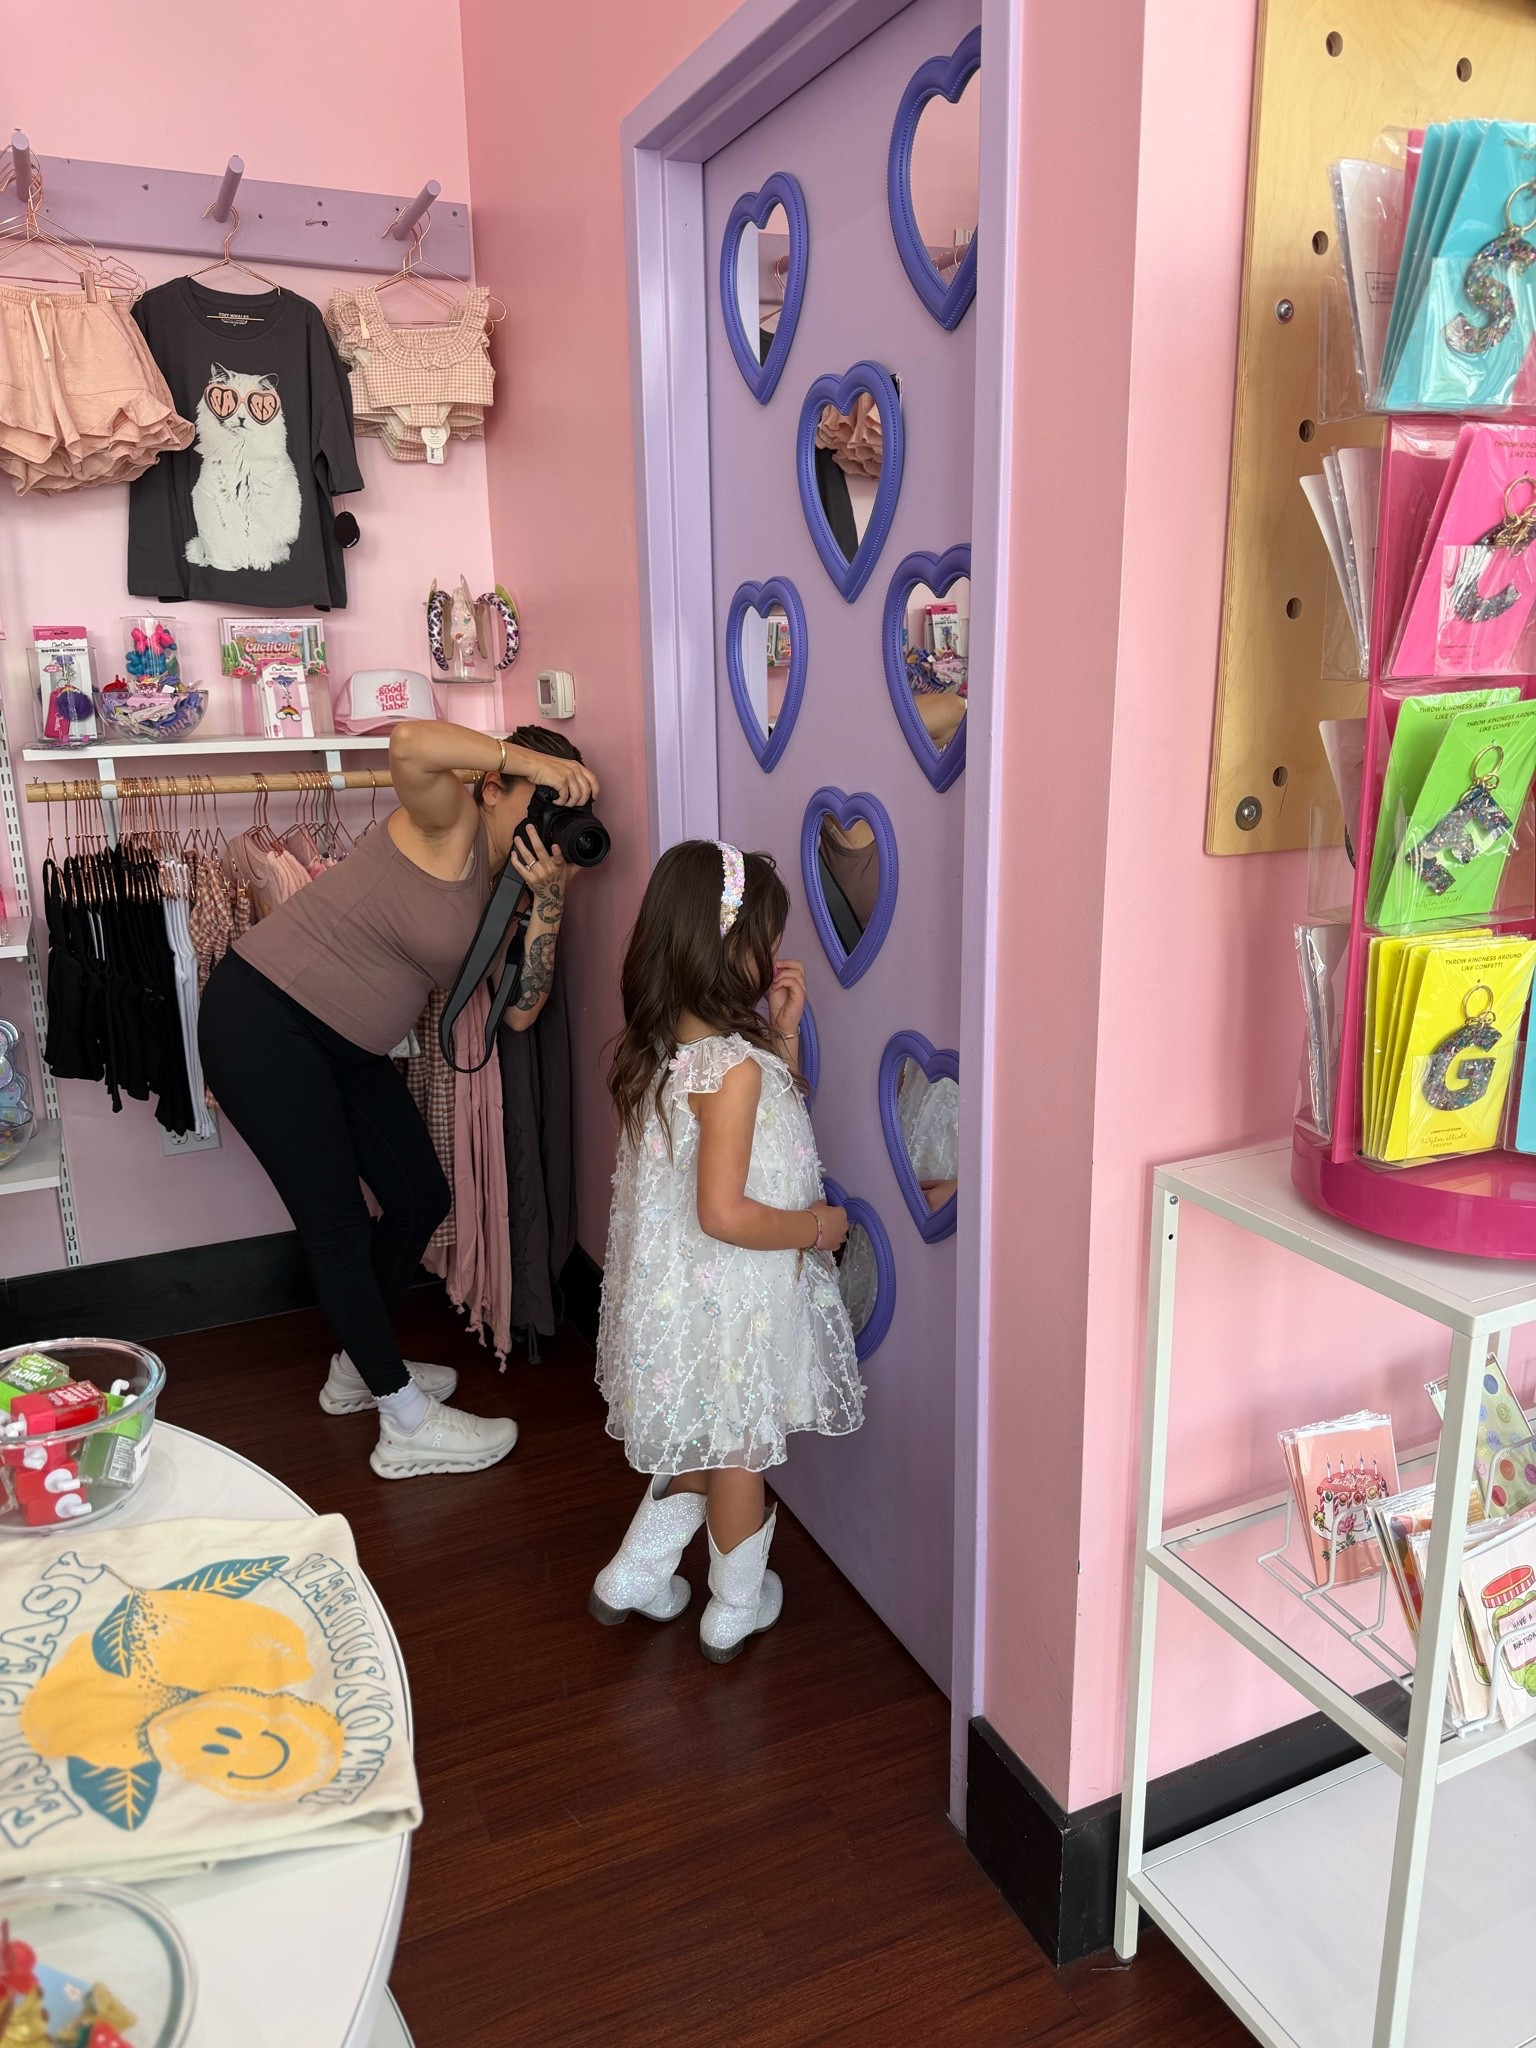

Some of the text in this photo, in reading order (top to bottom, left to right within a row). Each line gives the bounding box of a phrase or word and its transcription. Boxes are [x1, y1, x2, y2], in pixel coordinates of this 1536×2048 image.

[378, 683, 402, 696] good
[381, 701, 408, 711] babe!
[1420, 706, 1442, 714] THROW
[1466, 720, 1487, 728] THROW
[1487, 714, 1515, 724] KINDNESS
[1492, 721, 1520, 730] CONFETTI
[1468, 955, 1496, 963] KINDNESS
[1497, 952, 1522, 960] AROUND
[1475, 962, 1503, 970] CONFETTI
[1422, 1023, 1502, 1111] G
[11, 1367, 48, 1387] JUICY
[1512, 1615, 1528, 1630] HAVE
[1513, 1631, 1536, 1651] BIRTHDA
